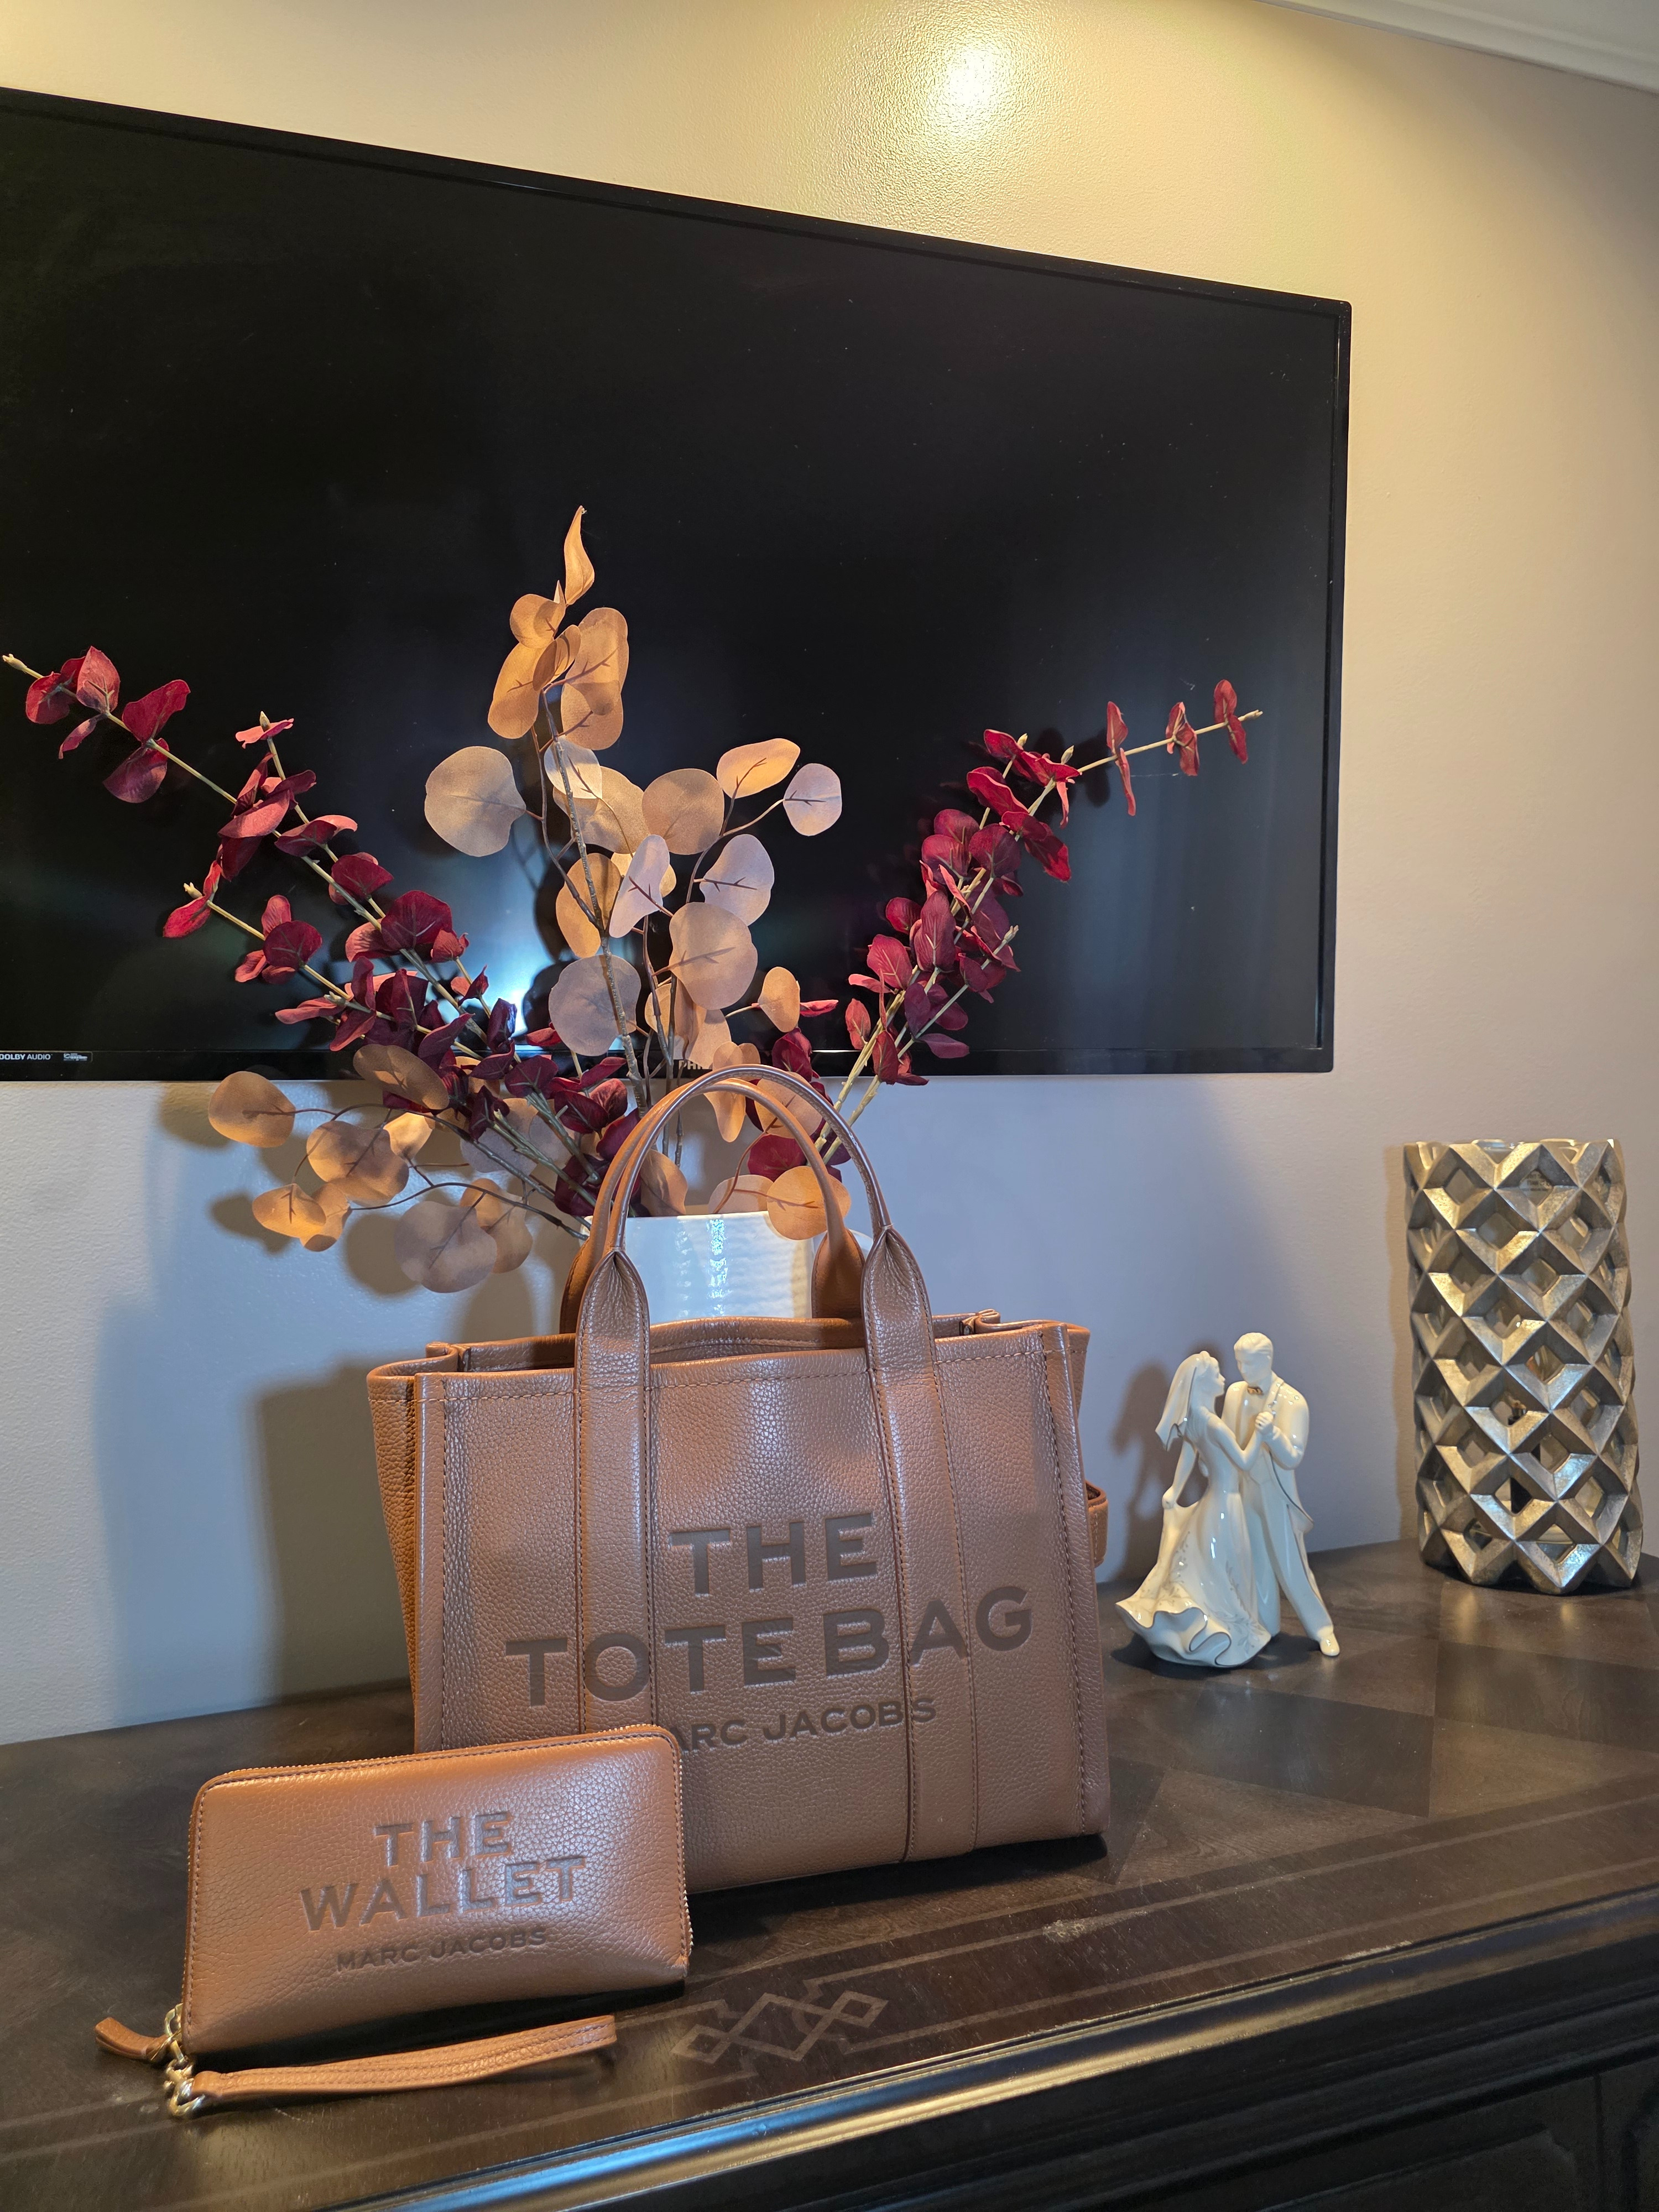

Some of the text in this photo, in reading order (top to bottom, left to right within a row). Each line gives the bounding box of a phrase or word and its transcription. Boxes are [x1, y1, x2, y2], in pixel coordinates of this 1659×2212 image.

[669, 1512, 878, 1597] THE
[505, 1585, 1032, 1707] TOTE BAG
[763, 1698, 937, 1741] JACOBS
[374, 1811, 510, 1866] THE
[300, 1855, 585, 1932] WALLET
[336, 1929, 547, 1971] MARC JACOBS
